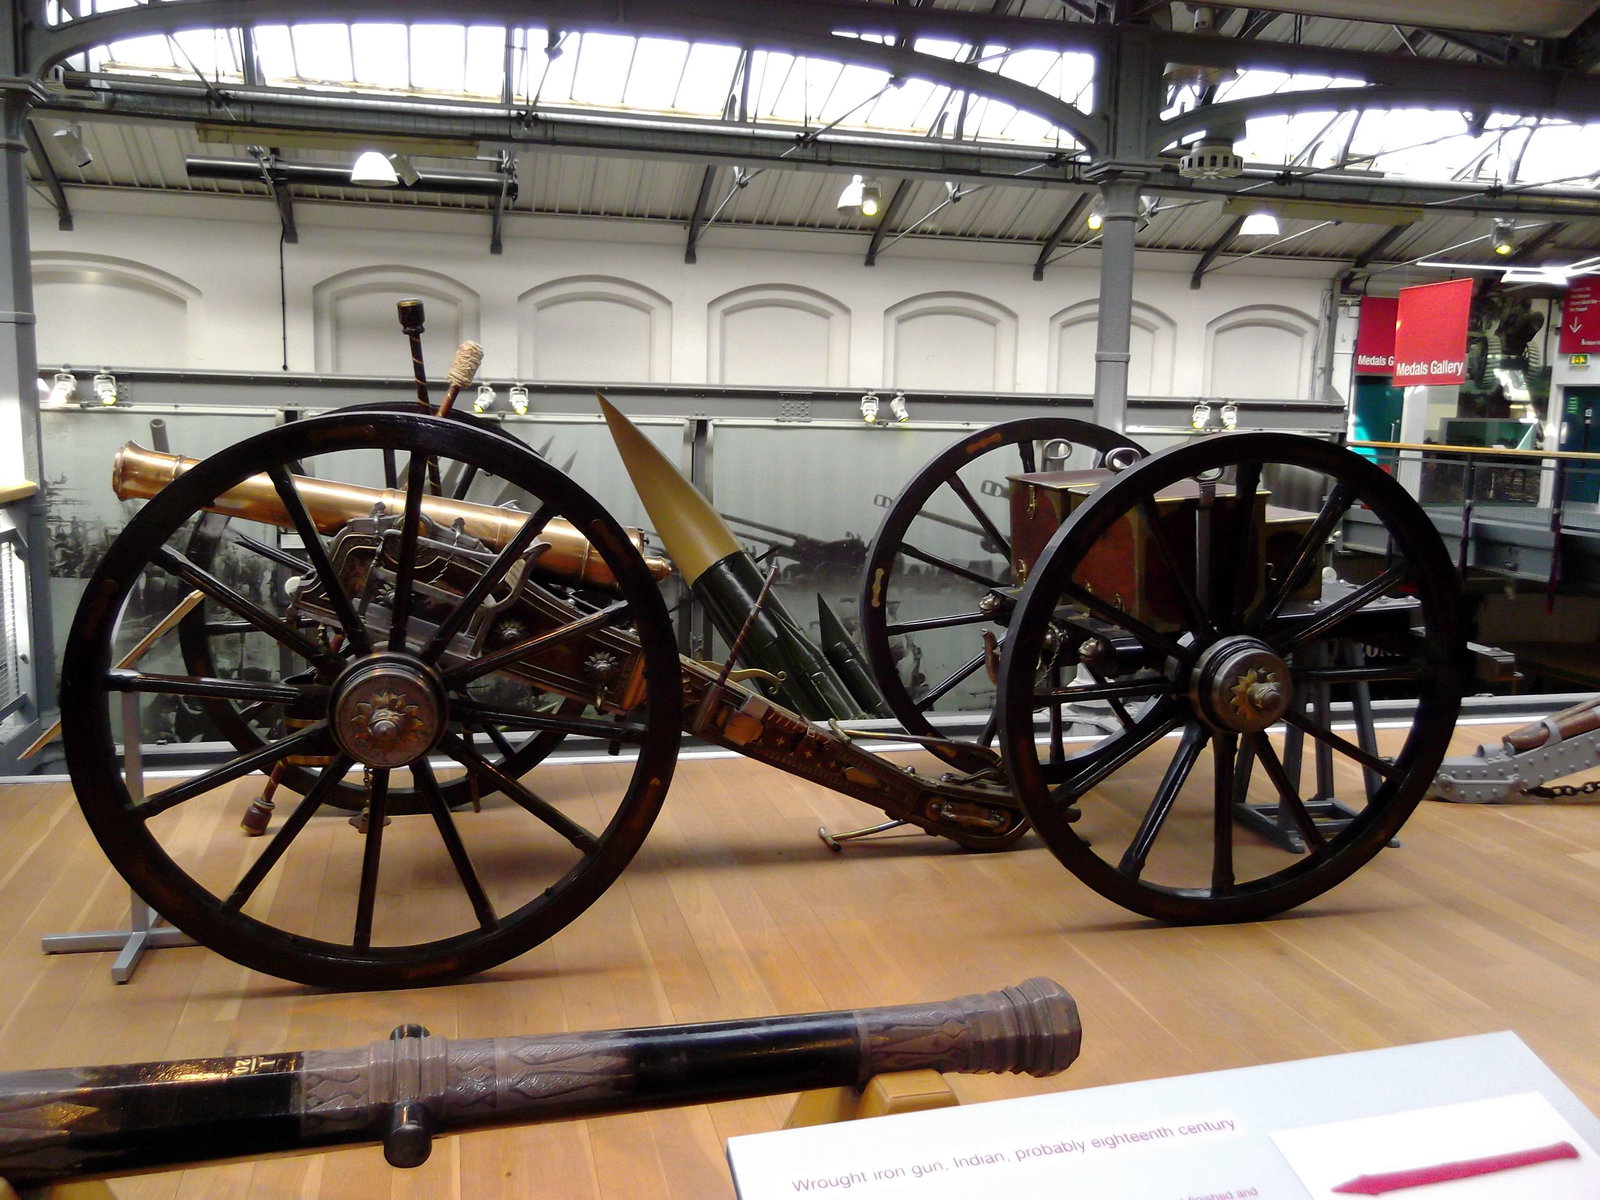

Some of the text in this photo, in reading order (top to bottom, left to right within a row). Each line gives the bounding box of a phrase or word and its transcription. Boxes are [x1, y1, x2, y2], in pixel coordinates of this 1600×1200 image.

[1358, 354, 1387, 366] Medals
[1396, 360, 1464, 376] Medals Gallery
[791, 1118, 1236, 1192] Wrought iron gun, Indian, probably eighteenth century
[1236, 1186, 1259, 1198] and
